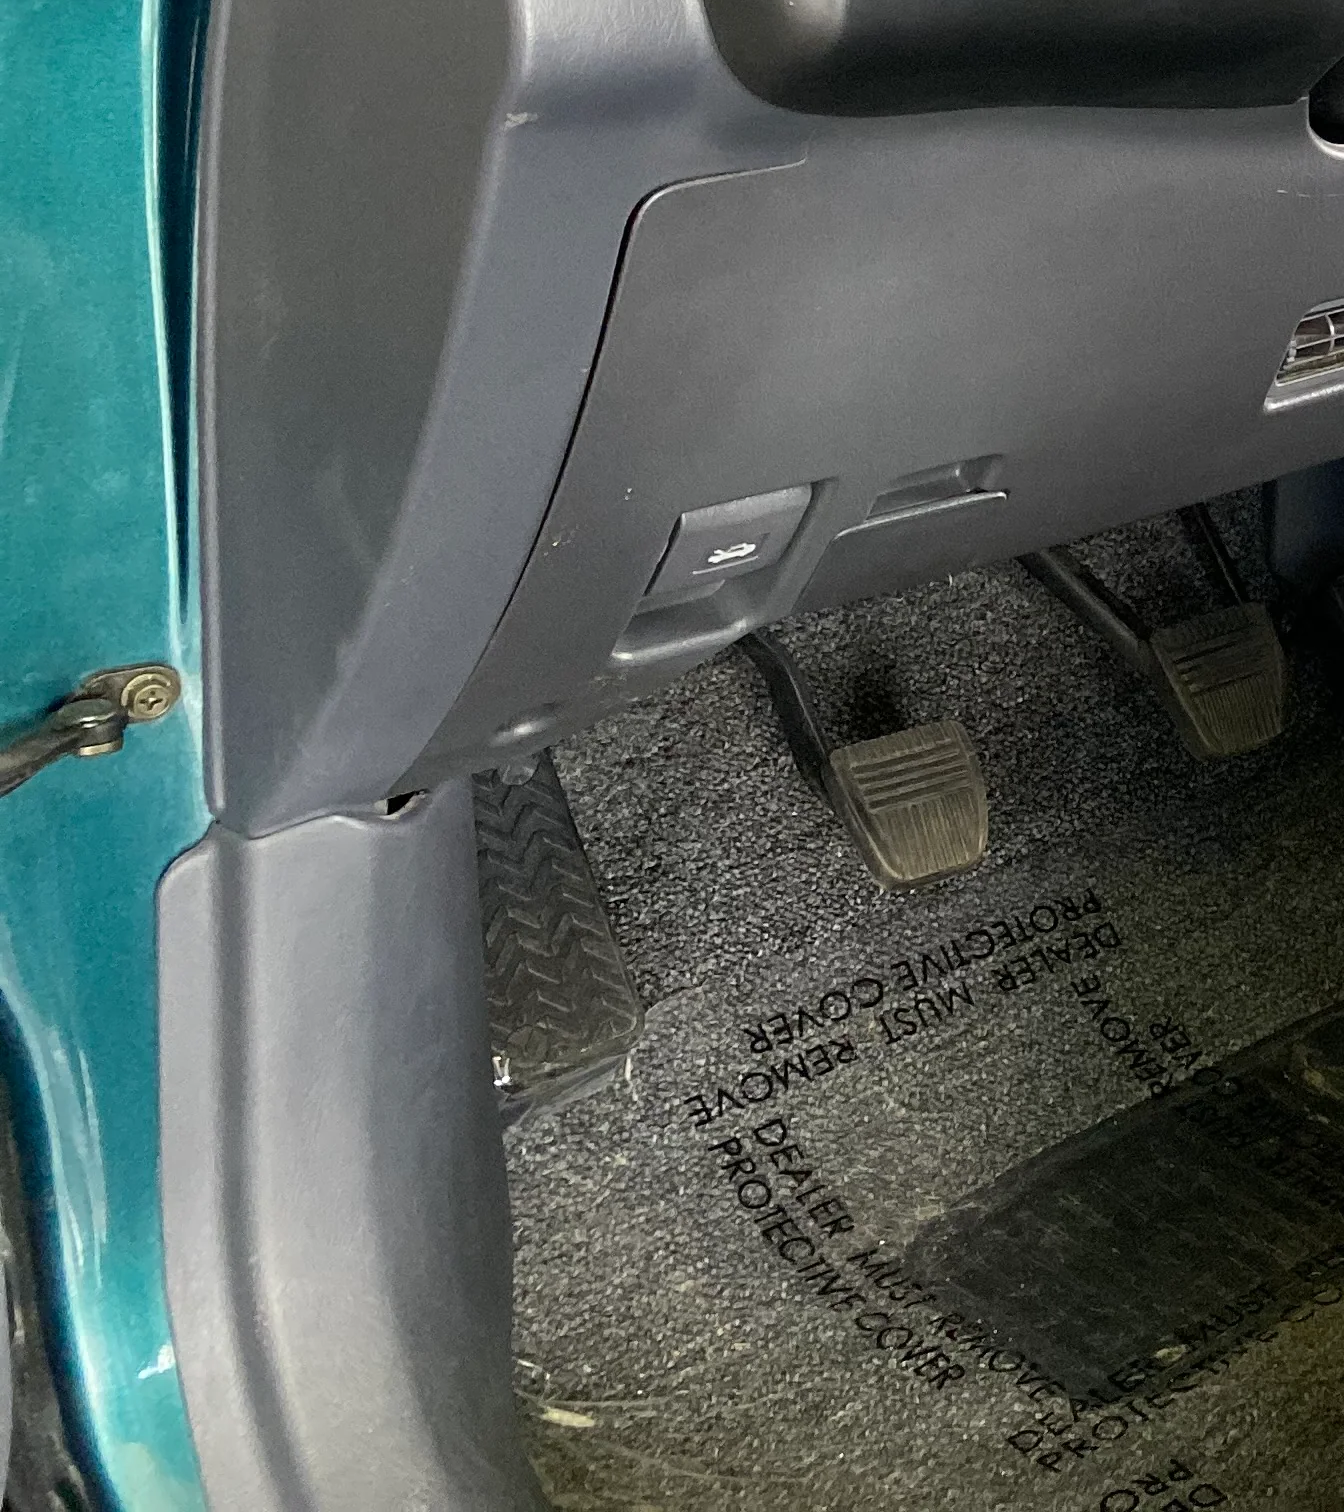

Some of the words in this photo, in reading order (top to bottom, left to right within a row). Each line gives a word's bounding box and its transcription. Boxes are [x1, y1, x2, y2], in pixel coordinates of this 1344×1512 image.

[891, 888, 1103, 991] PROTECTIVE
[993, 921, 1123, 995] DEALER
[742, 977, 885, 1055] COVER
[876, 980, 976, 1046] MUST
[683, 1033, 857, 1129] REMOVE
[706, 1136, 868, 1312] PROTECTIVE
[853, 1310, 966, 1390] COVER
[753, 1116, 856, 1237] DEALER
[846, 1247, 938, 1308] MUST
[929, 1311, 1068, 1399] REMOVE
